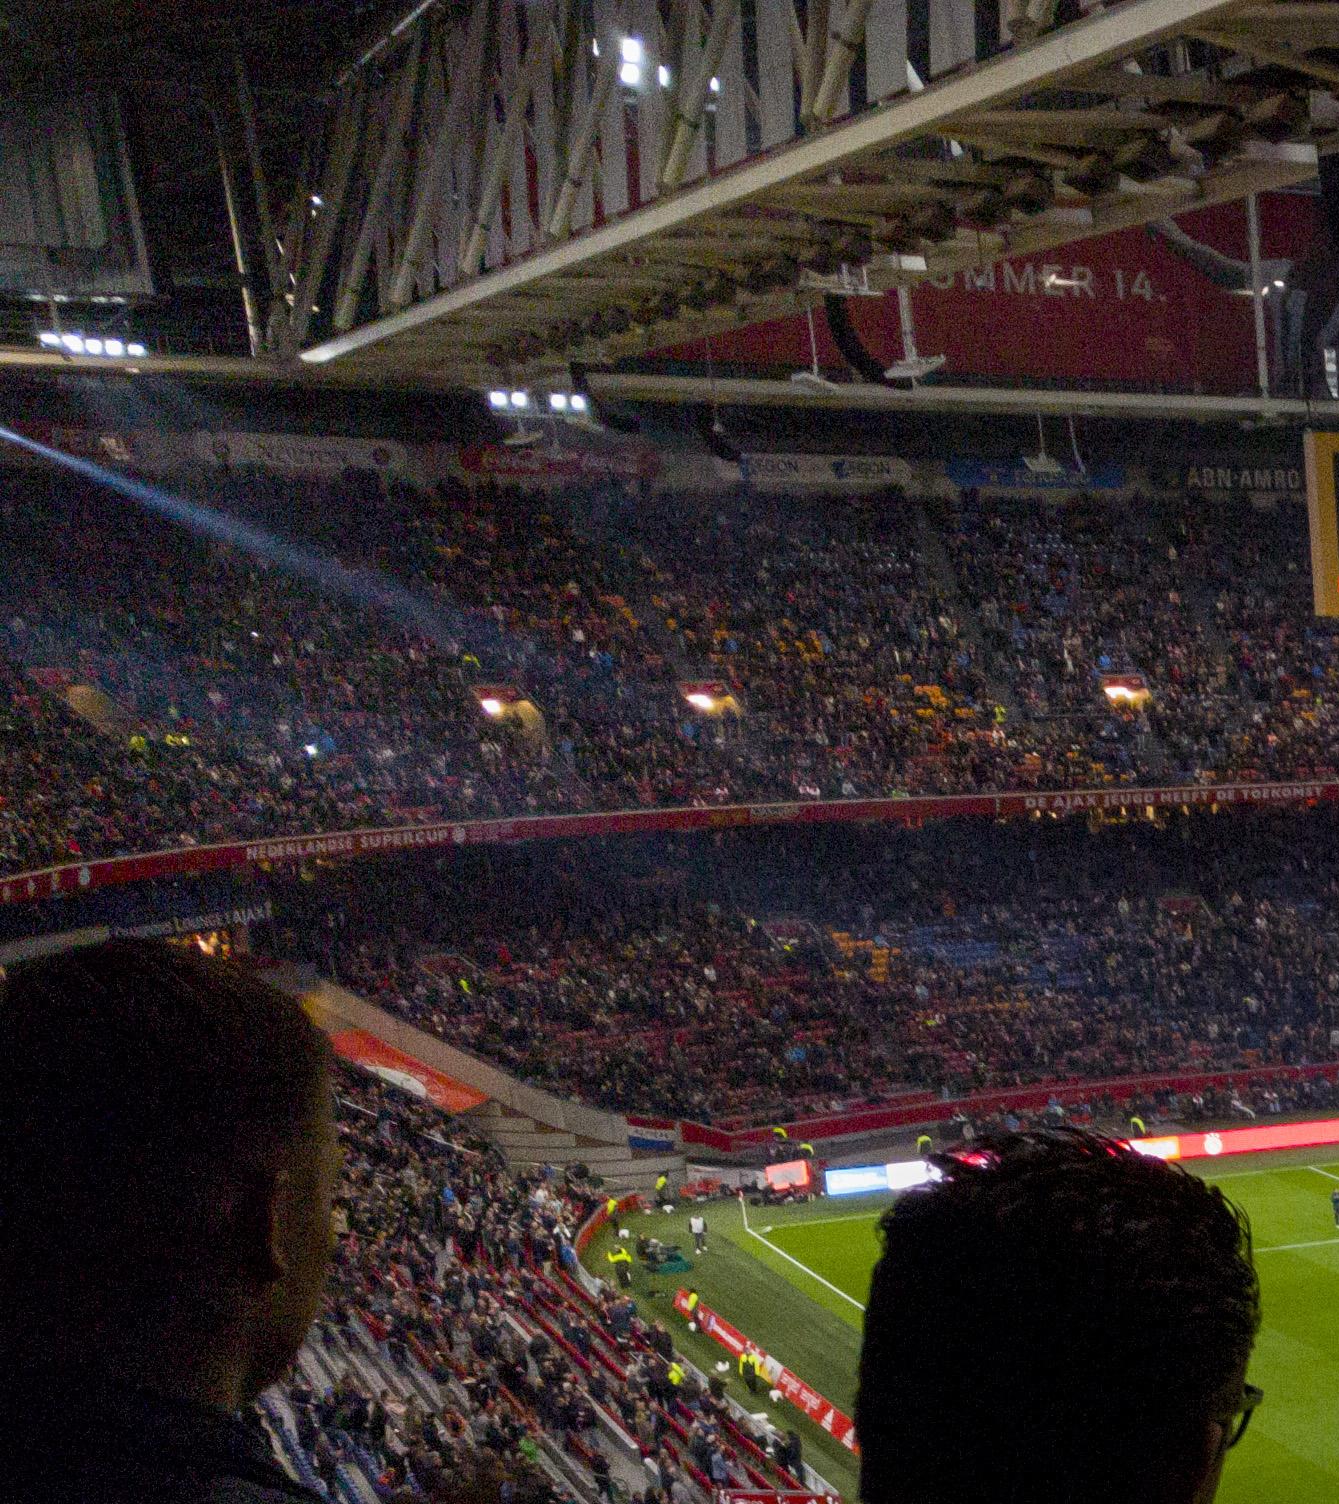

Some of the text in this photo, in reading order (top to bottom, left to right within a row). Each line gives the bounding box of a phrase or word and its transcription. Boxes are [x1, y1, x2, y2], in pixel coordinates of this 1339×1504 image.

[912, 260, 1096, 299] UMMER
[1025, 785, 1323, 810] DE AJAX JEUGD HEEFT DE TOEKOMST
[246, 828, 449, 860] NEDERLANDSE SUPERCUP
